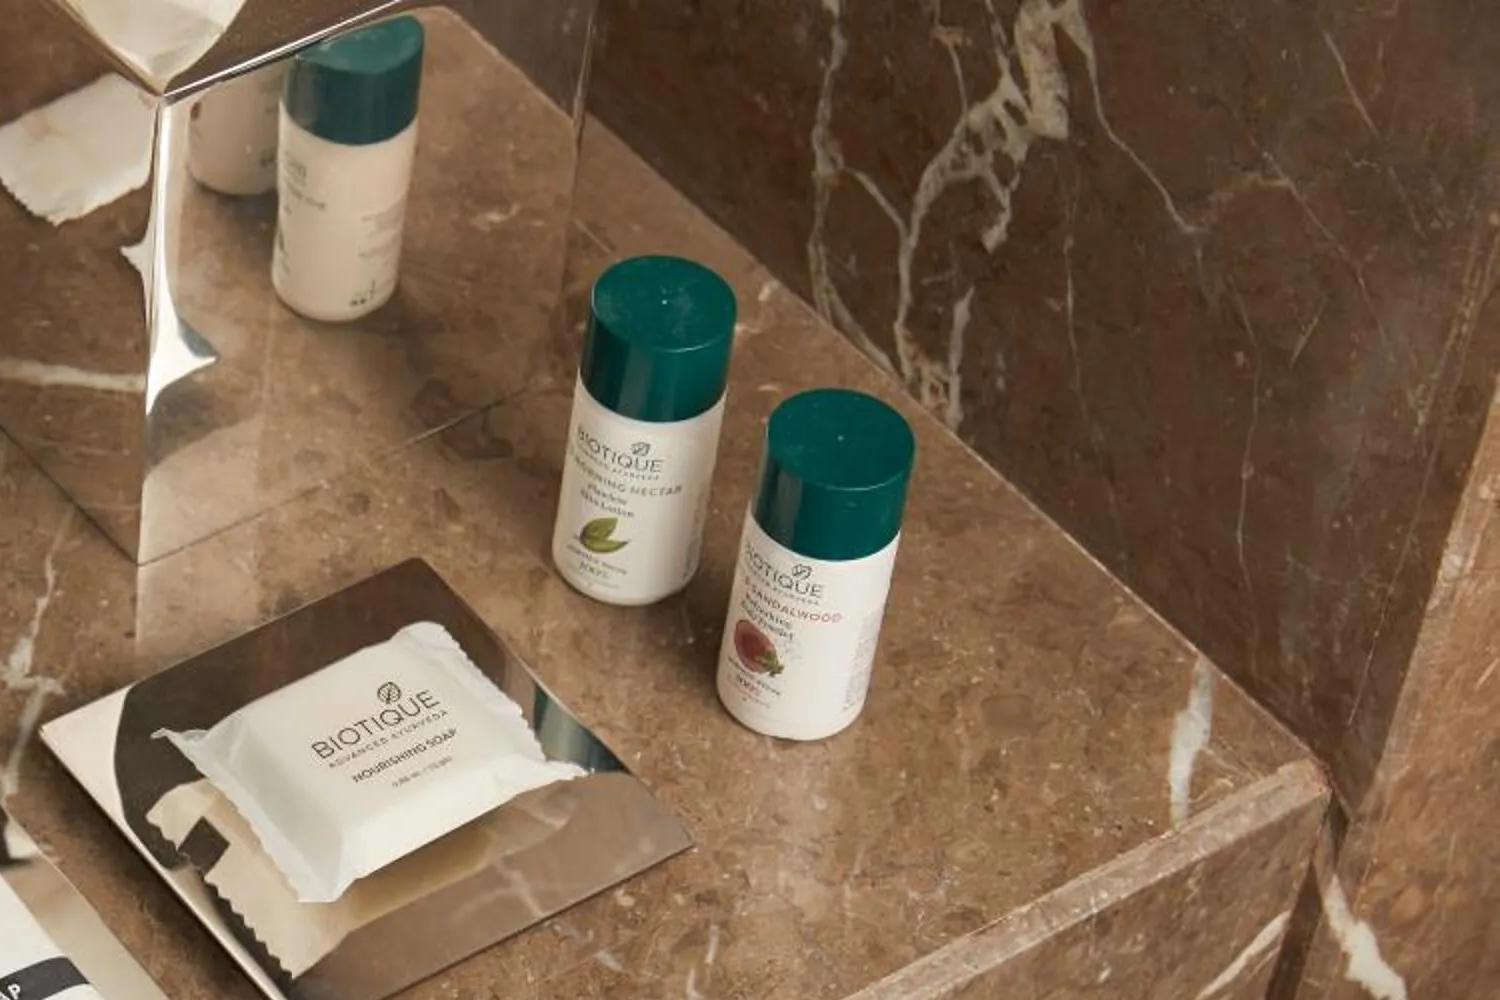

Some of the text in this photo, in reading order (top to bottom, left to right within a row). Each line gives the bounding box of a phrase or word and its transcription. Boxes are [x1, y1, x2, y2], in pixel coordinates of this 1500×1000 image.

[311, 689, 441, 760] BIOTIQUE
[328, 737, 389, 769] ADVANCED
[352, 743, 427, 783] NOURISHING
[425, 727, 458, 748] SOAP
